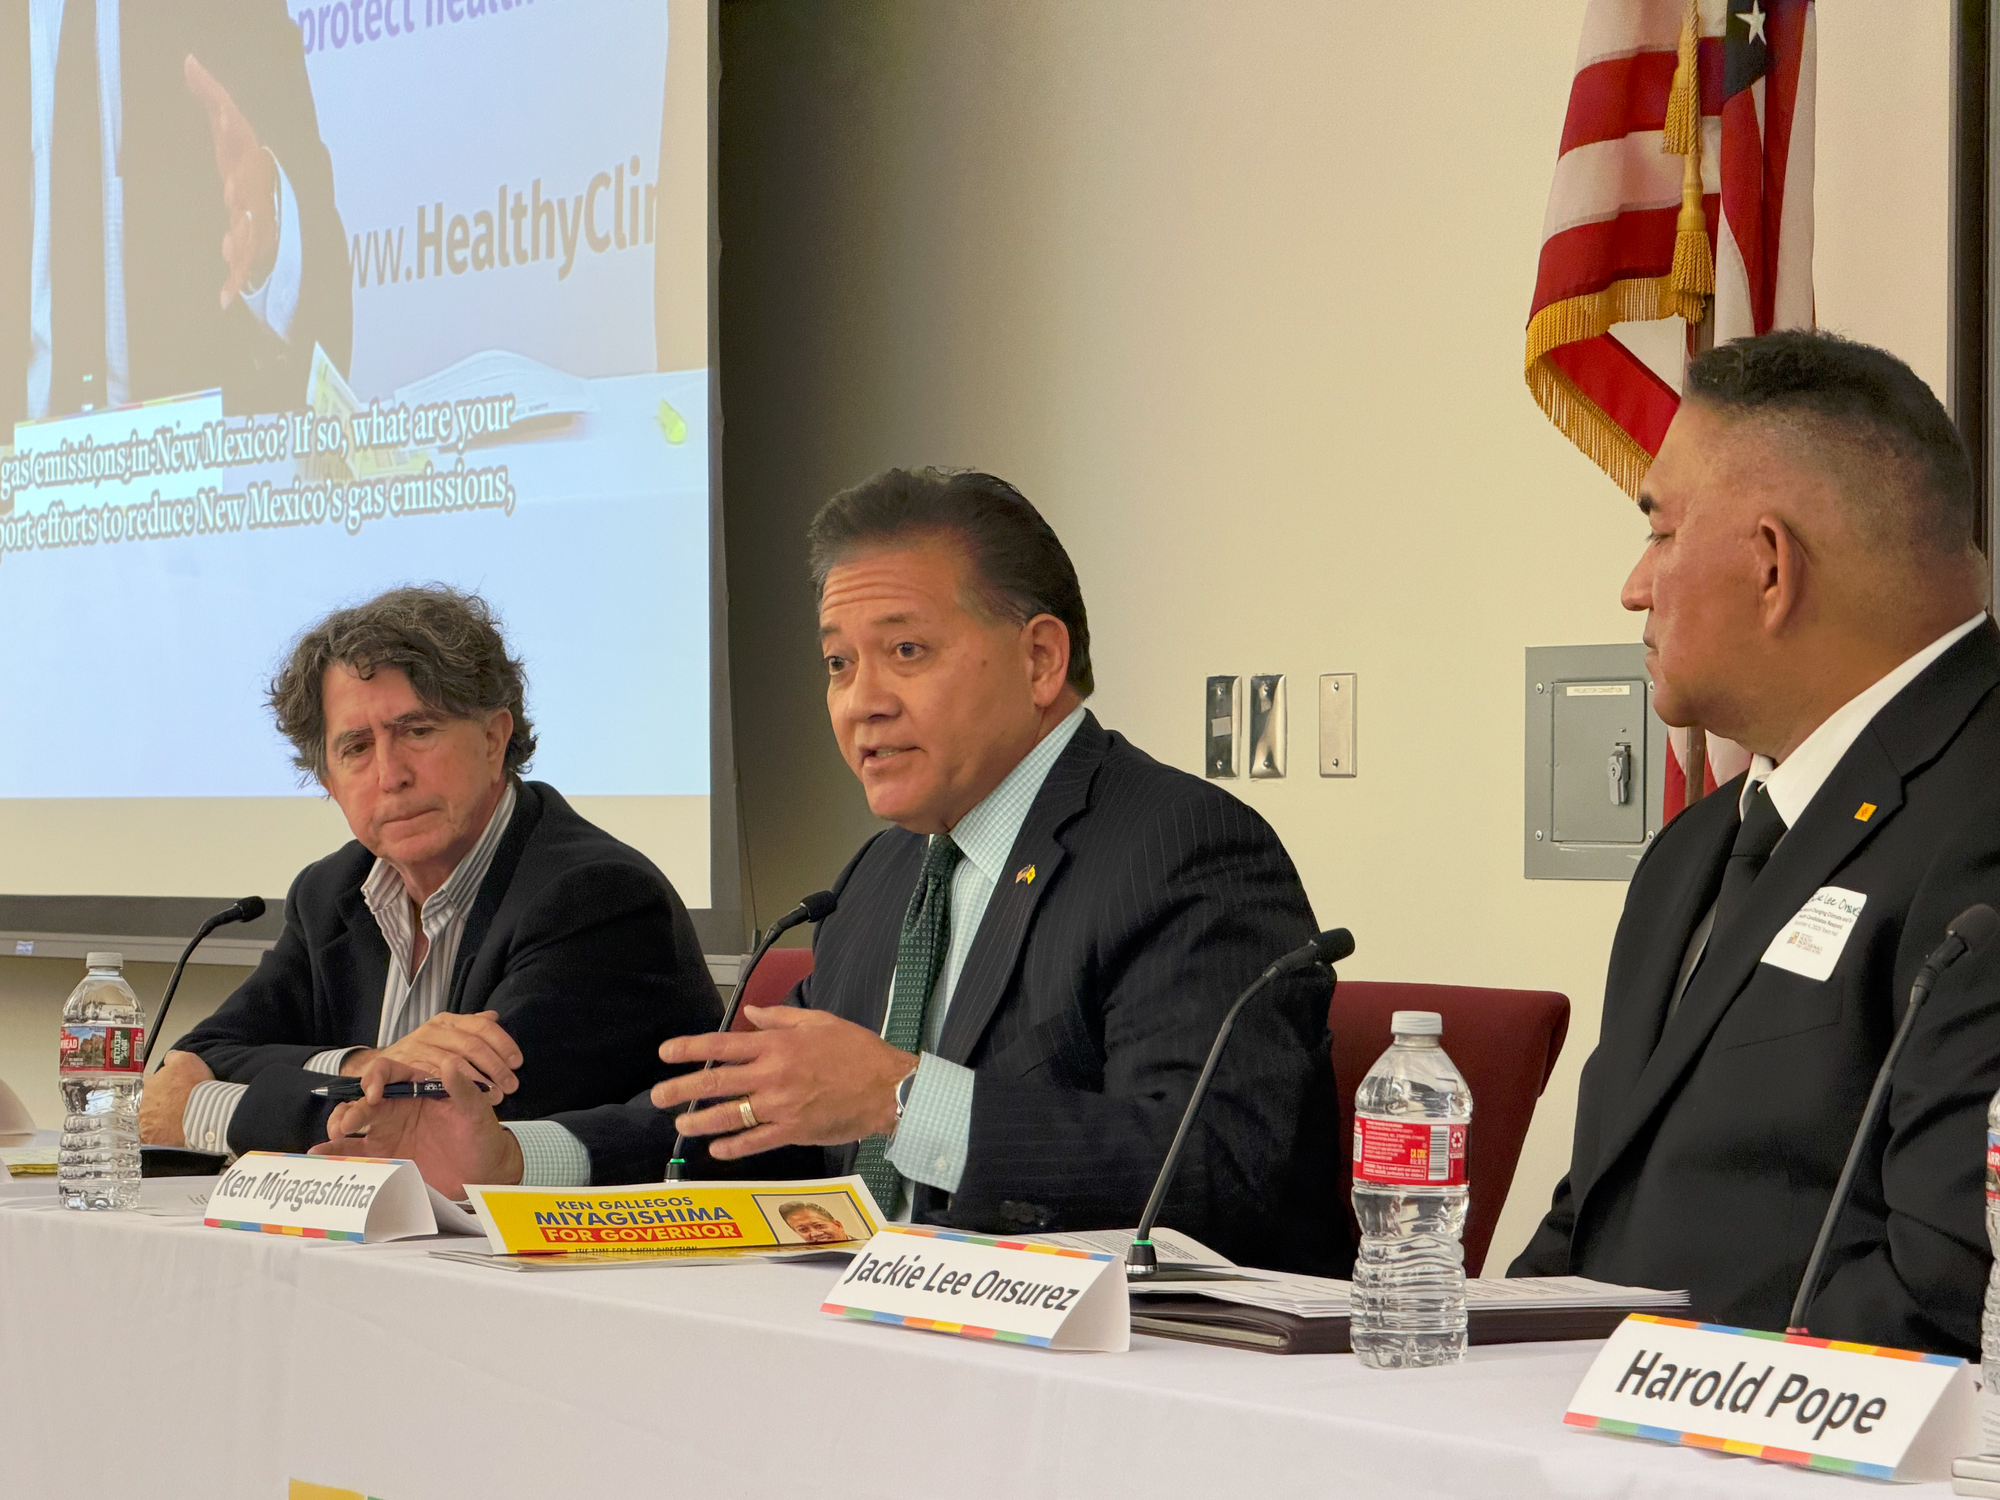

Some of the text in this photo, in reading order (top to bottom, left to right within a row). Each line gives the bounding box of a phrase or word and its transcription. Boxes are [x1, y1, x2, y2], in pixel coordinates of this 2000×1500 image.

[0, 399, 514, 499] gas emissions in New Mexico? If so, what are your
[0, 463, 514, 548] ort efforts to reduce New Mexico's gas emissions,
[216, 1169, 376, 1212] Ken Miyagashima
[556, 1196, 694, 1210] KEN GALLEGOS
[534, 1207, 734, 1226] MIYAGISHIMA
[544, 1223, 738, 1242] FOR GOVERNOR
[844, 1252, 1080, 1312] Jackie Lee Onsurez
[1615, 1349, 1887, 1440] Harold Pope
